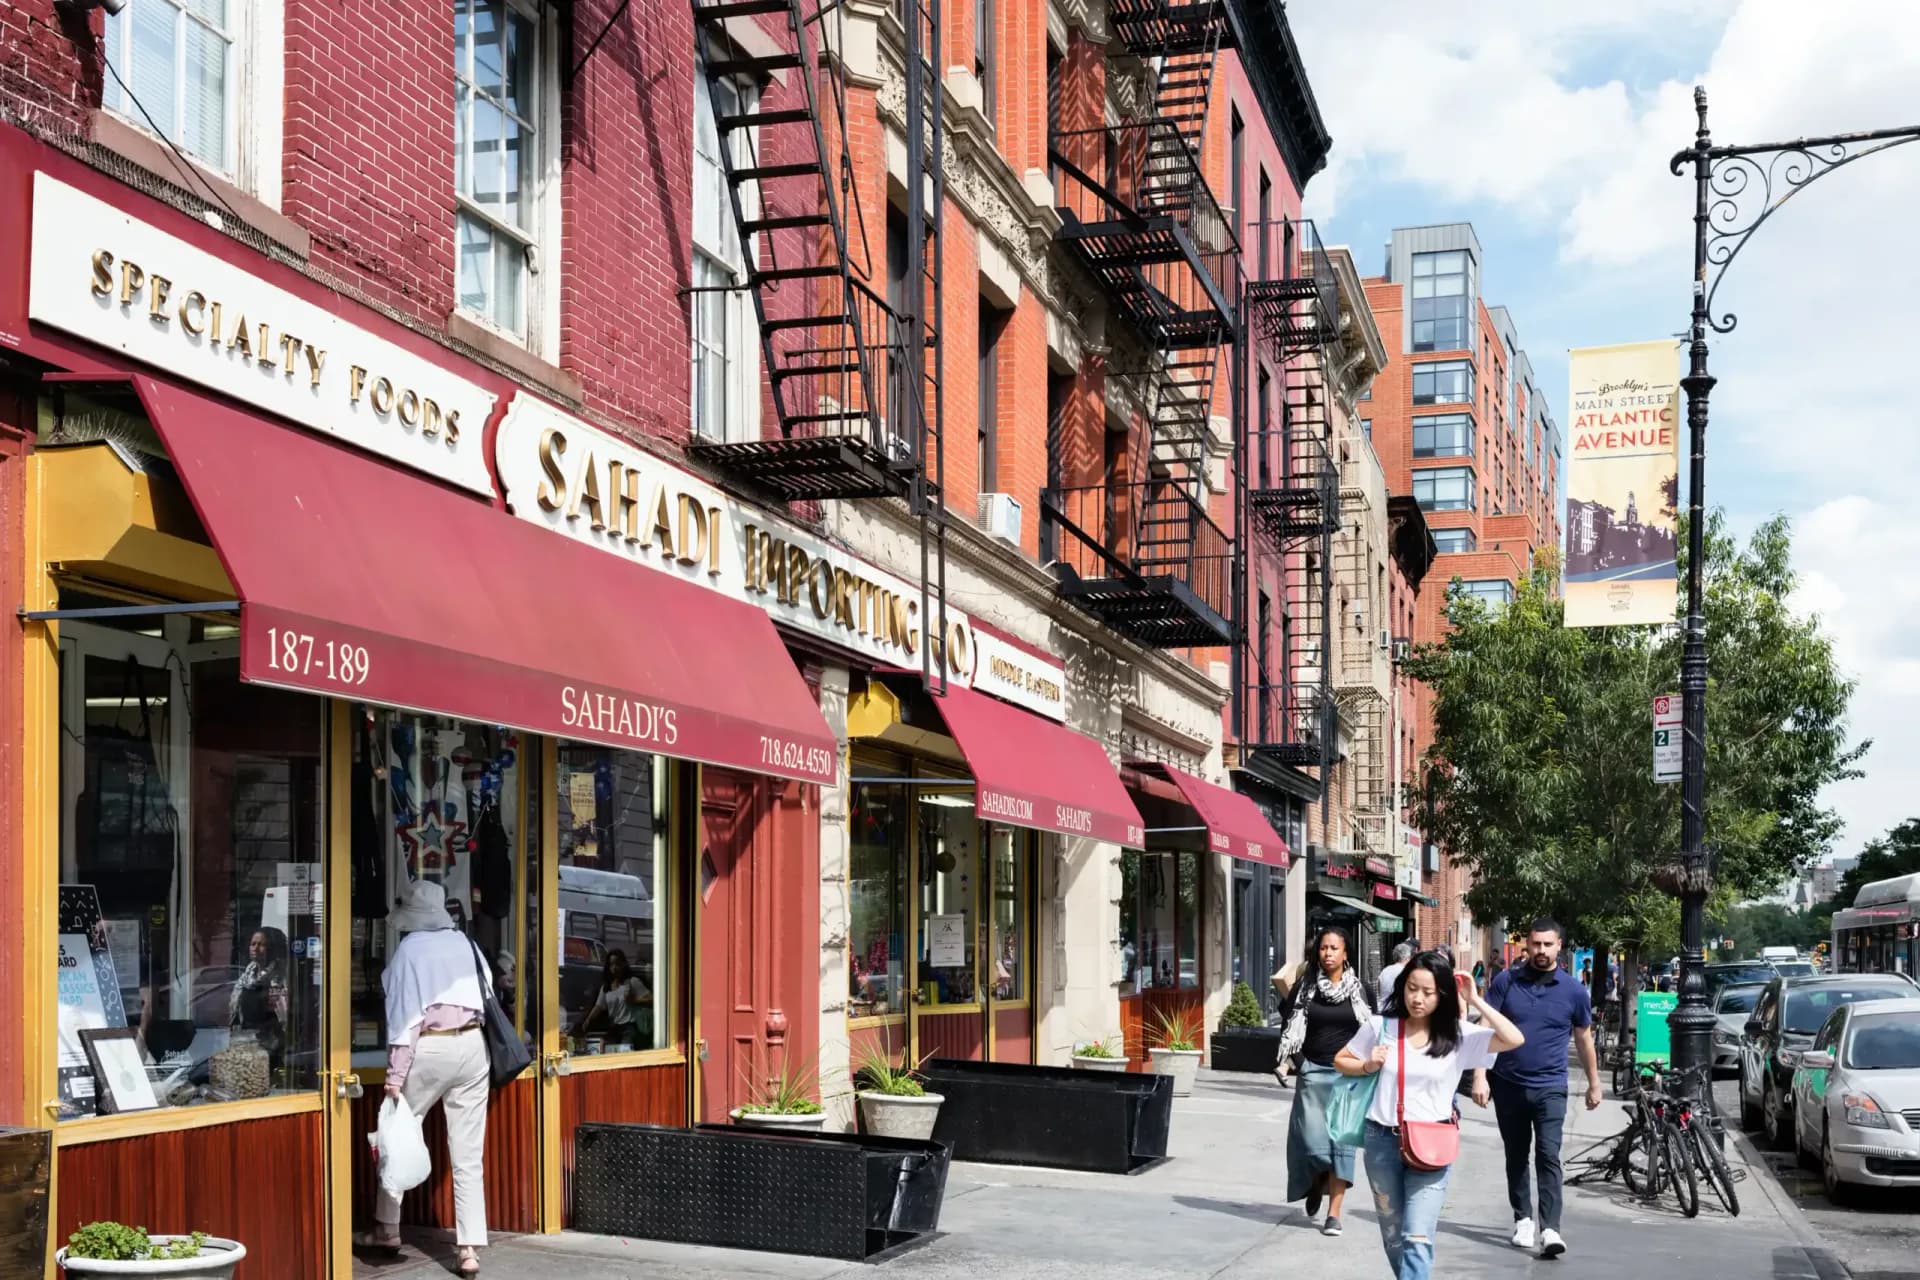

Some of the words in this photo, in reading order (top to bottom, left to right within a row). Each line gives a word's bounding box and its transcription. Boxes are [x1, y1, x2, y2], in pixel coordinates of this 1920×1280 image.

[91, 248, 327, 386] SPECIALTY
[351, 364, 461, 447] FOODS
[1575, 398, 1613, 411] MAIN
[1620, 393, 1673, 407] STREET
[1599, 379, 1649, 396] Brooklyn's
[1575, 408, 1672, 429] ATLANTIC
[1574, 428, 1672, 450] AVENUE
[537, 428, 721, 575] SAHADI
[744, 524, 918, 656] IMPORTING
[267, 627, 369, 685] 187-189
[561, 686, 678, 744] SAHADI'S
[1657, 731, 1666, 746] 2
[760, 735, 831, 776] 718.624.4550
[982, 790, 1032, 820] SAHADIS.COM
[1056, 804, 1091, 832] SAHADI'S
